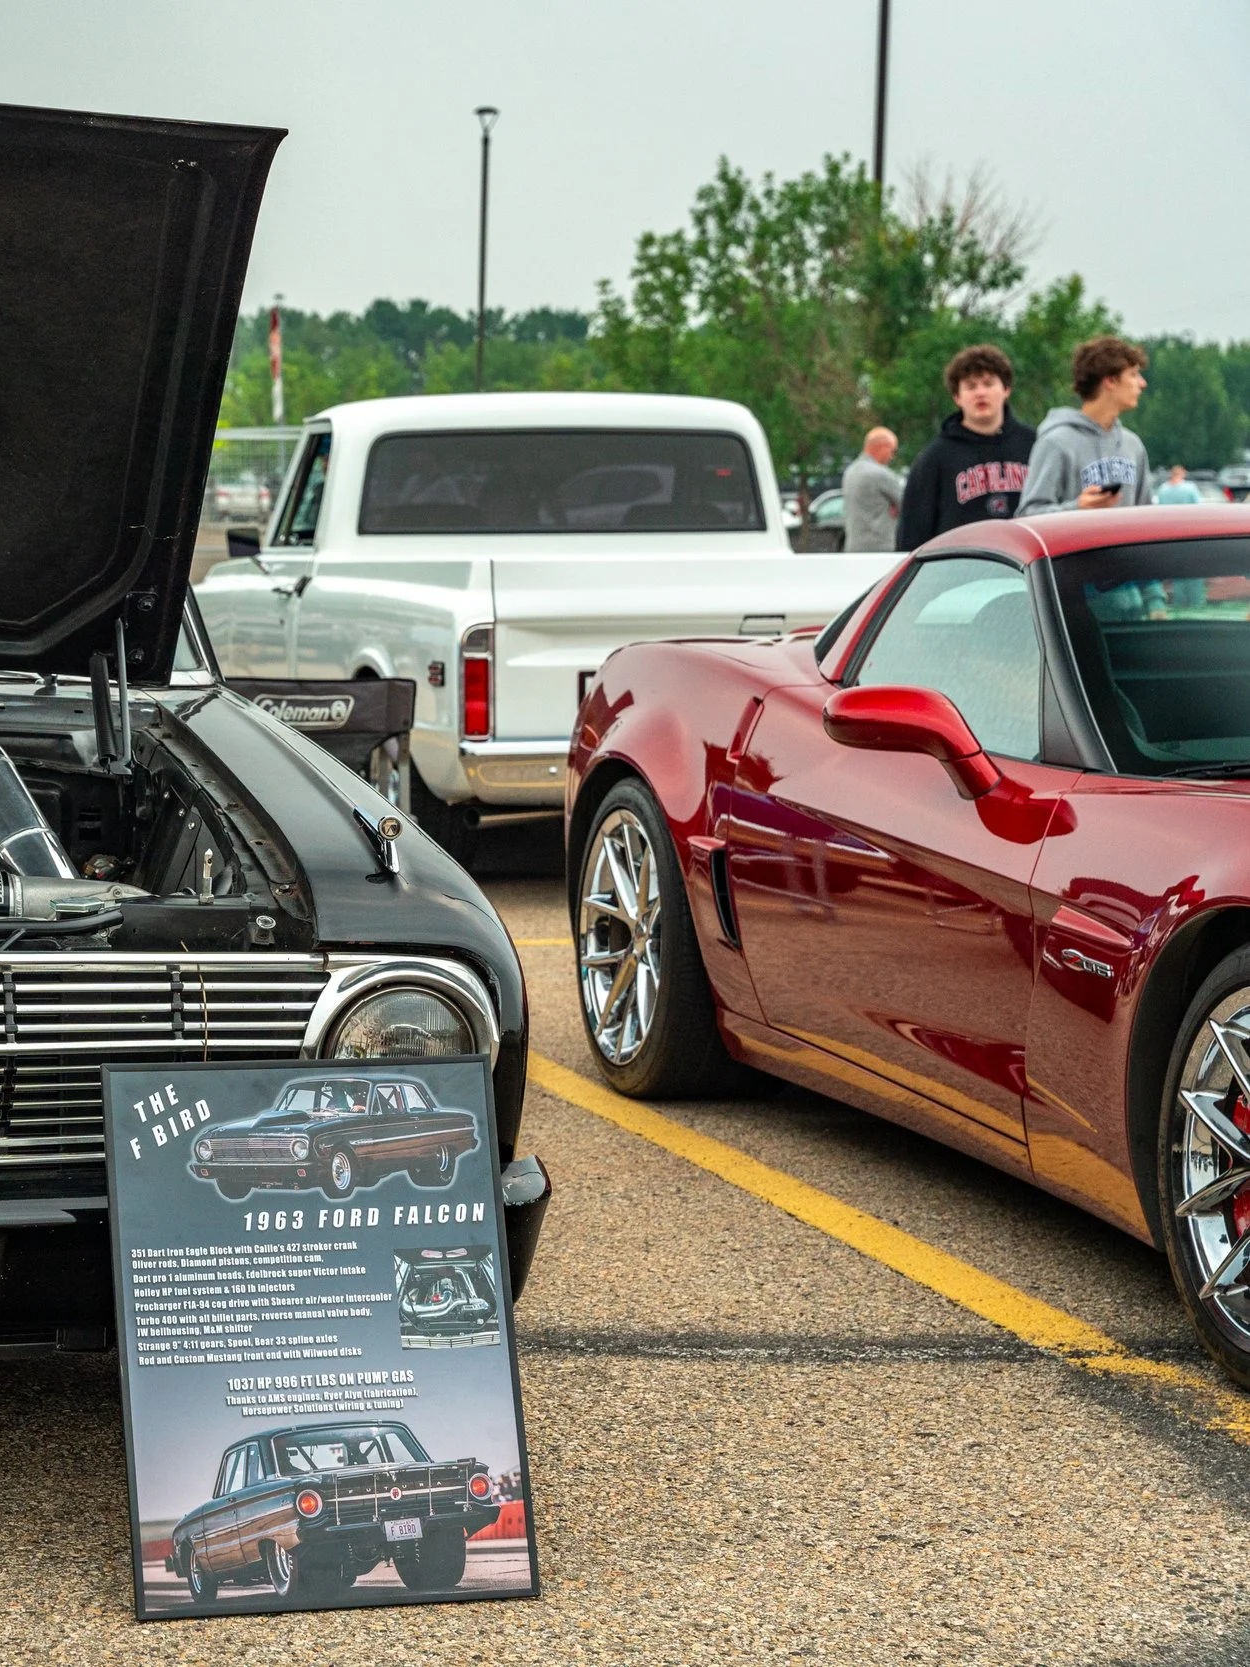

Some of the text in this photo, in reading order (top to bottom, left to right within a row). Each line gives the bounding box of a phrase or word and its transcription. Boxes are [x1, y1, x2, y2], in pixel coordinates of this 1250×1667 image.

[956, 462, 1029, 504] CAROLIN
[133, 1083, 180, 1124] THE
[129, 1098, 211, 1160] F BIRD
[243, 1202, 486, 1231] 1963 FORD FALCON
[131, 1249, 146, 1258] 351
[147, 1248, 165, 1257] Dart
[185, 1246, 208, 1256] Eagle
[210, 1246, 234, 1255] Block
[235, 1245, 252, 1254] with
[286, 1243, 301, 1252] 427
[302, 1242, 332, 1251] stroker
[333, 1241, 358, 1250] crank
[132, 1260, 157, 1269] Oliver
[181, 1257, 217, 1267] Diamond
[253, 1254, 303, 1265] competition
[133, 1274, 151, 1283] Dart
[152, 1275, 167, 1283] pro
[168, 1273, 173, 1282] 1
[174, 1272, 216, 1281] aluminum
[246, 1269, 286, 1279] Edelbrock
[288, 1269, 312, 1278] super
[313, 1267, 338, 1276] Victor
[134, 1283, 295, 1297] Holley HP fuel system & 160 lb injectors
[135, 1302, 181, 1311] Procharger
[183, 1300, 210, 1309] F1A-94
[211, 1300, 227, 1309] cog
[228, 1298, 250, 1308] drive
[251, 1297, 270, 1307] with
[271, 1296, 304, 1306] Shearer
[305, 1295, 344, 1304] air/water
[136, 1316, 160, 1325] Turbo
[161, 1316, 177, 1324] 400
[179, 1315, 197, 1324] with
[199, 1314, 210, 1323] all
[211, 1313, 234, 1322] billet
[236, 1312, 260, 1322] parts,
[261, 1311, 293, 1320] reverse
[294, 1309, 325, 1319] manual
[326, 1308, 348, 1318] valve
[136, 1324, 252, 1337] JW bellhousing, M&M shifter
[137, 1342, 170, 1351] Strange
[183, 1340, 199, 1349] 4:11
[275, 1336, 286, 1345] 33
[287, 1335, 314, 1345] spline
[315, 1334, 338, 1343] axles
[138, 1347, 362, 1366] Rod and Custom Mustang front end with Wilwood disks
[227, 1370, 415, 1391] 1037 HP 996 FT LBS ON PUMP GAS
[226, 1395, 256, 1406] Thanks
[257, 1395, 266, 1404] to
[267, 1393, 285, 1403] AMS
[242, 1405, 292, 1416] Horsepower
[294, 1403, 333, 1414] Solutions
[334, 1401, 364, 1412] (wiring
[374, 1400, 404, 1410] tuning)
